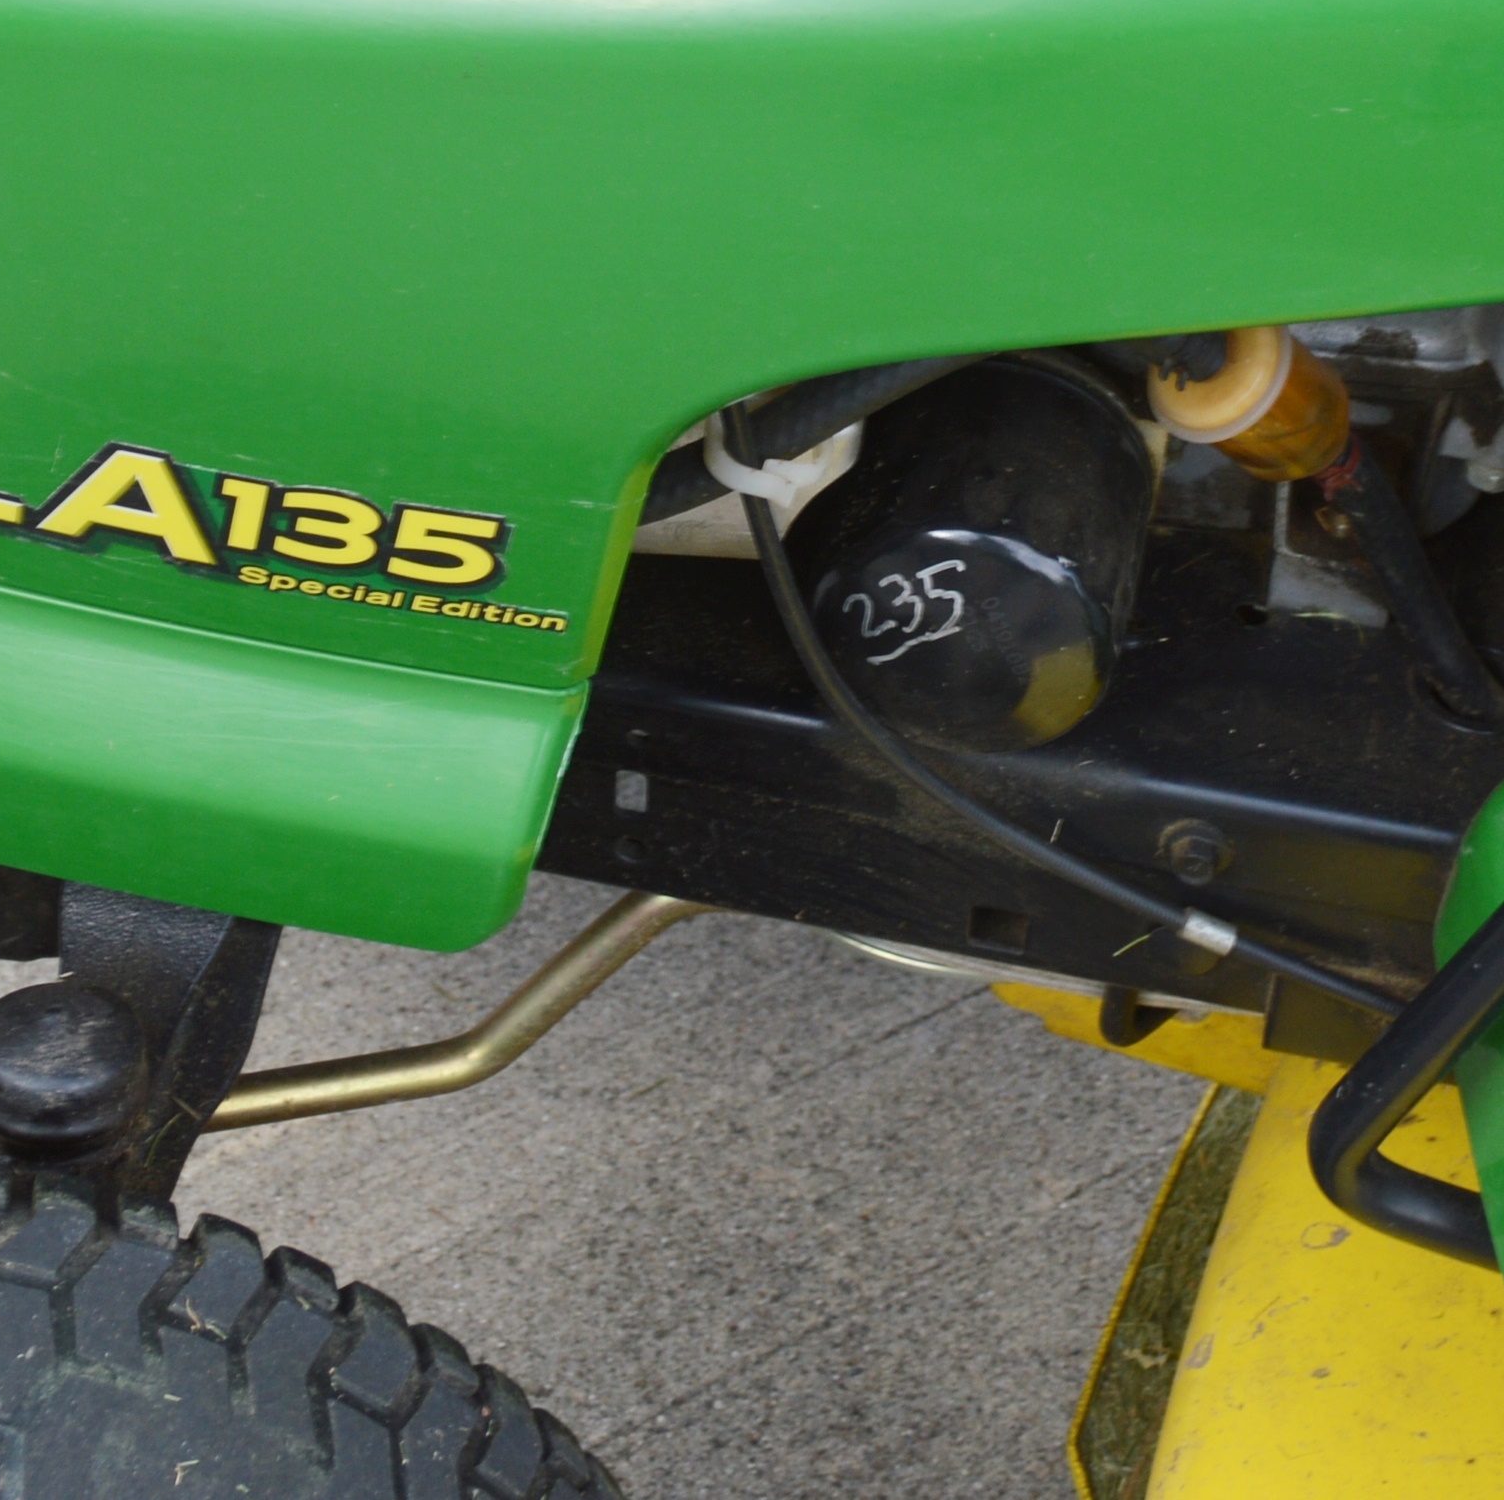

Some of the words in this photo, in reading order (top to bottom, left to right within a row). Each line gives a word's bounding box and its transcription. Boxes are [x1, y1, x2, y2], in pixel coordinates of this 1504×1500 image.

[237, 564, 406, 609] Special
[409, 594, 568, 632] Edition
[842, 558, 968, 639] 235
